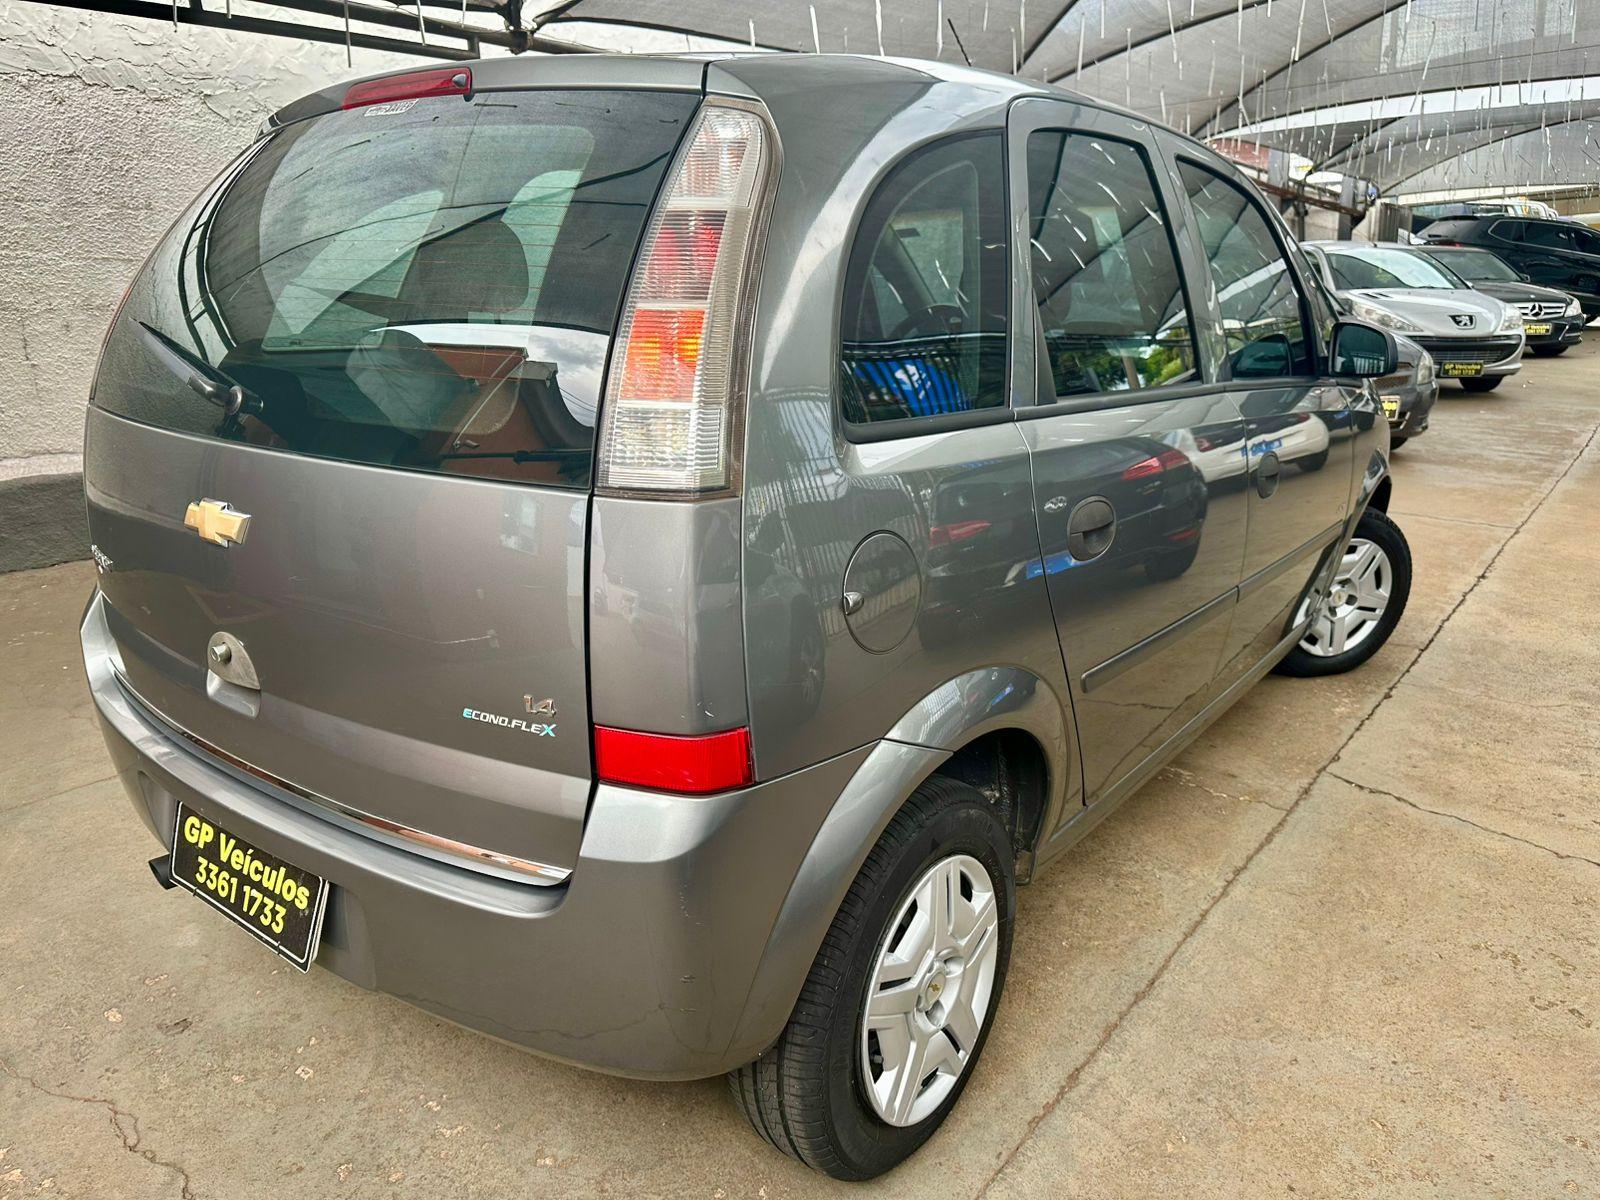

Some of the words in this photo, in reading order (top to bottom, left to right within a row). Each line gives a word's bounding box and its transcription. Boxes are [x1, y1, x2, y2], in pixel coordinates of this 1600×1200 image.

[462, 707, 557, 737] ECONO.FLEX
[184, 815, 214, 849] GP
[219, 832, 310, 910] Veículos
[195, 856, 238, 904] 3361
[242, 885, 287, 934] 1733
